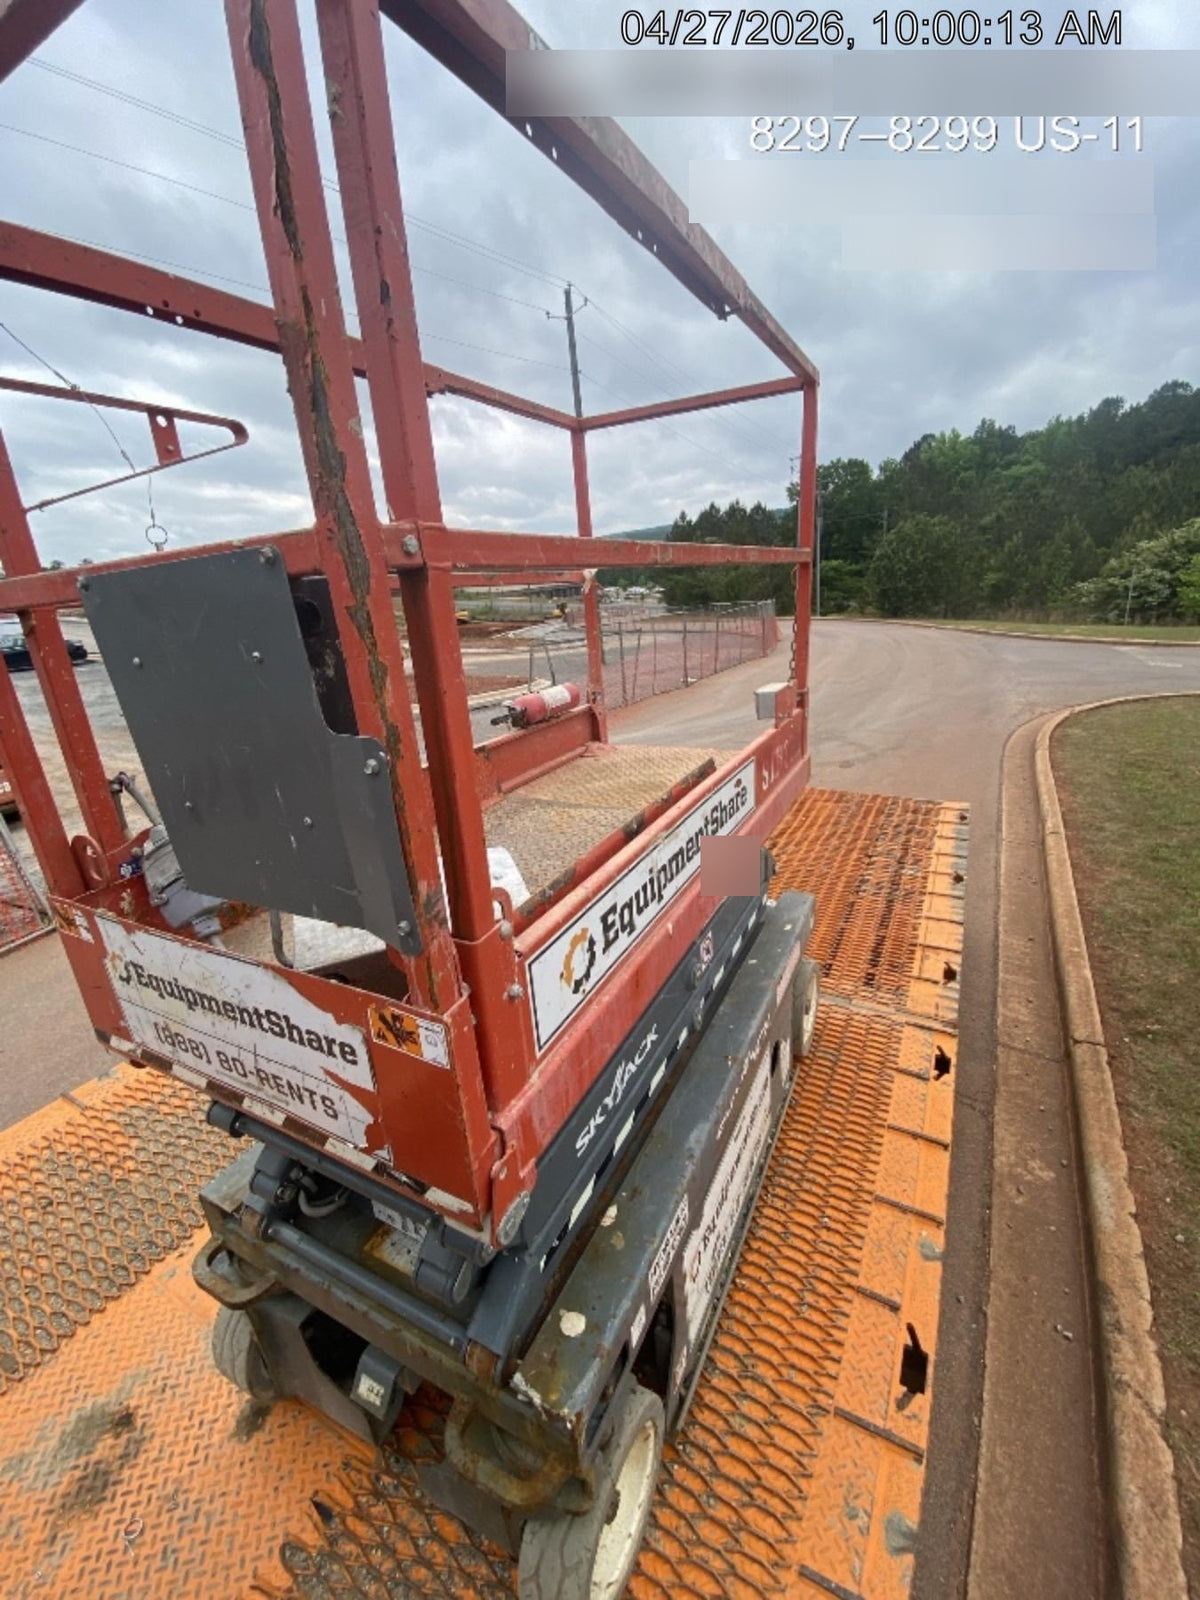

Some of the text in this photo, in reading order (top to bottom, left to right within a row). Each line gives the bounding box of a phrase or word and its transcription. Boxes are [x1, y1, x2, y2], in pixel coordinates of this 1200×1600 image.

[134, 960, 359, 1066] EquipmentShare
[153, 1021, 339, 1121] (888) 80-RENTS
[575, 1023, 658, 1158] SKYJACK
